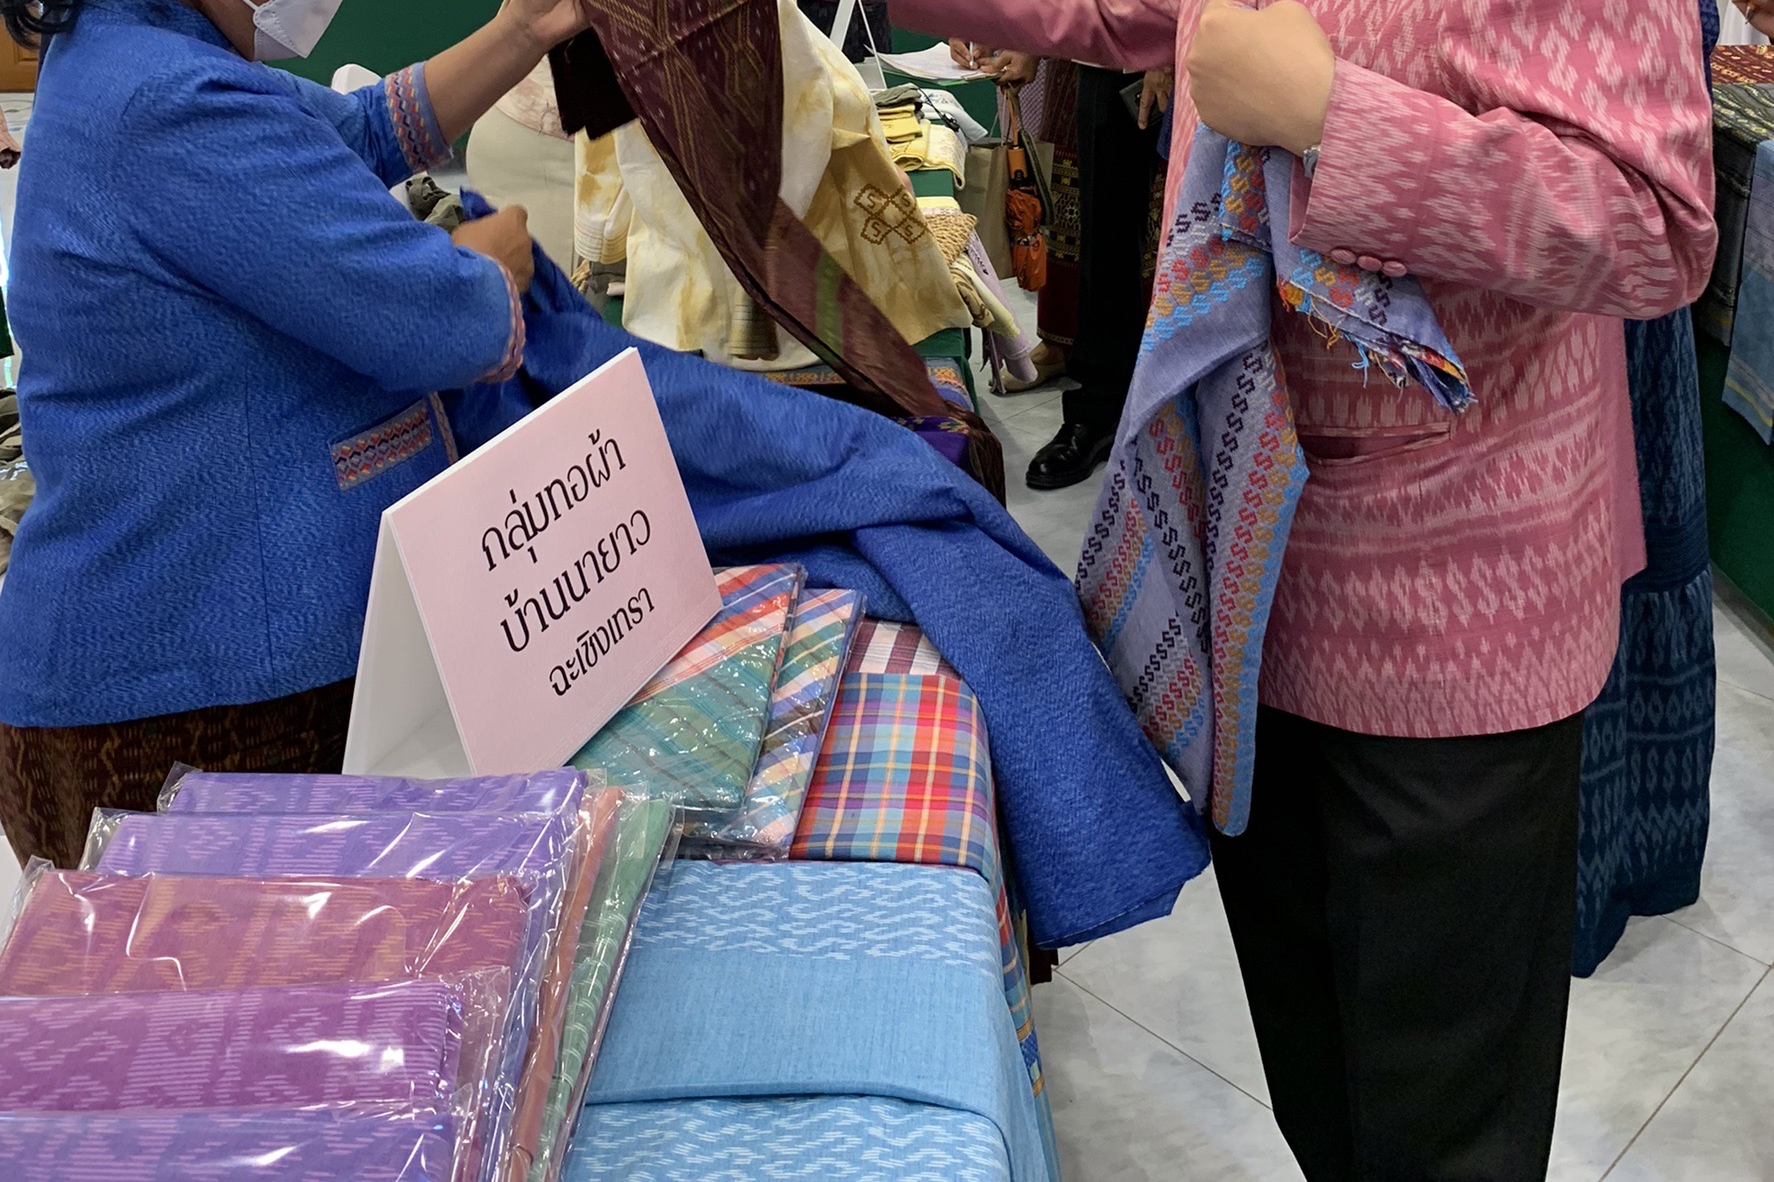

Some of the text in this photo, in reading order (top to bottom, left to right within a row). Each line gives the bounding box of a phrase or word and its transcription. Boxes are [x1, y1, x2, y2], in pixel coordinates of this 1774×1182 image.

[481, 428, 626, 571] กลุ่มทอผ้า
[500, 509, 651, 653] บ้านนายาว
[549, 587, 655, 697] ฉะเชิงเทรา
